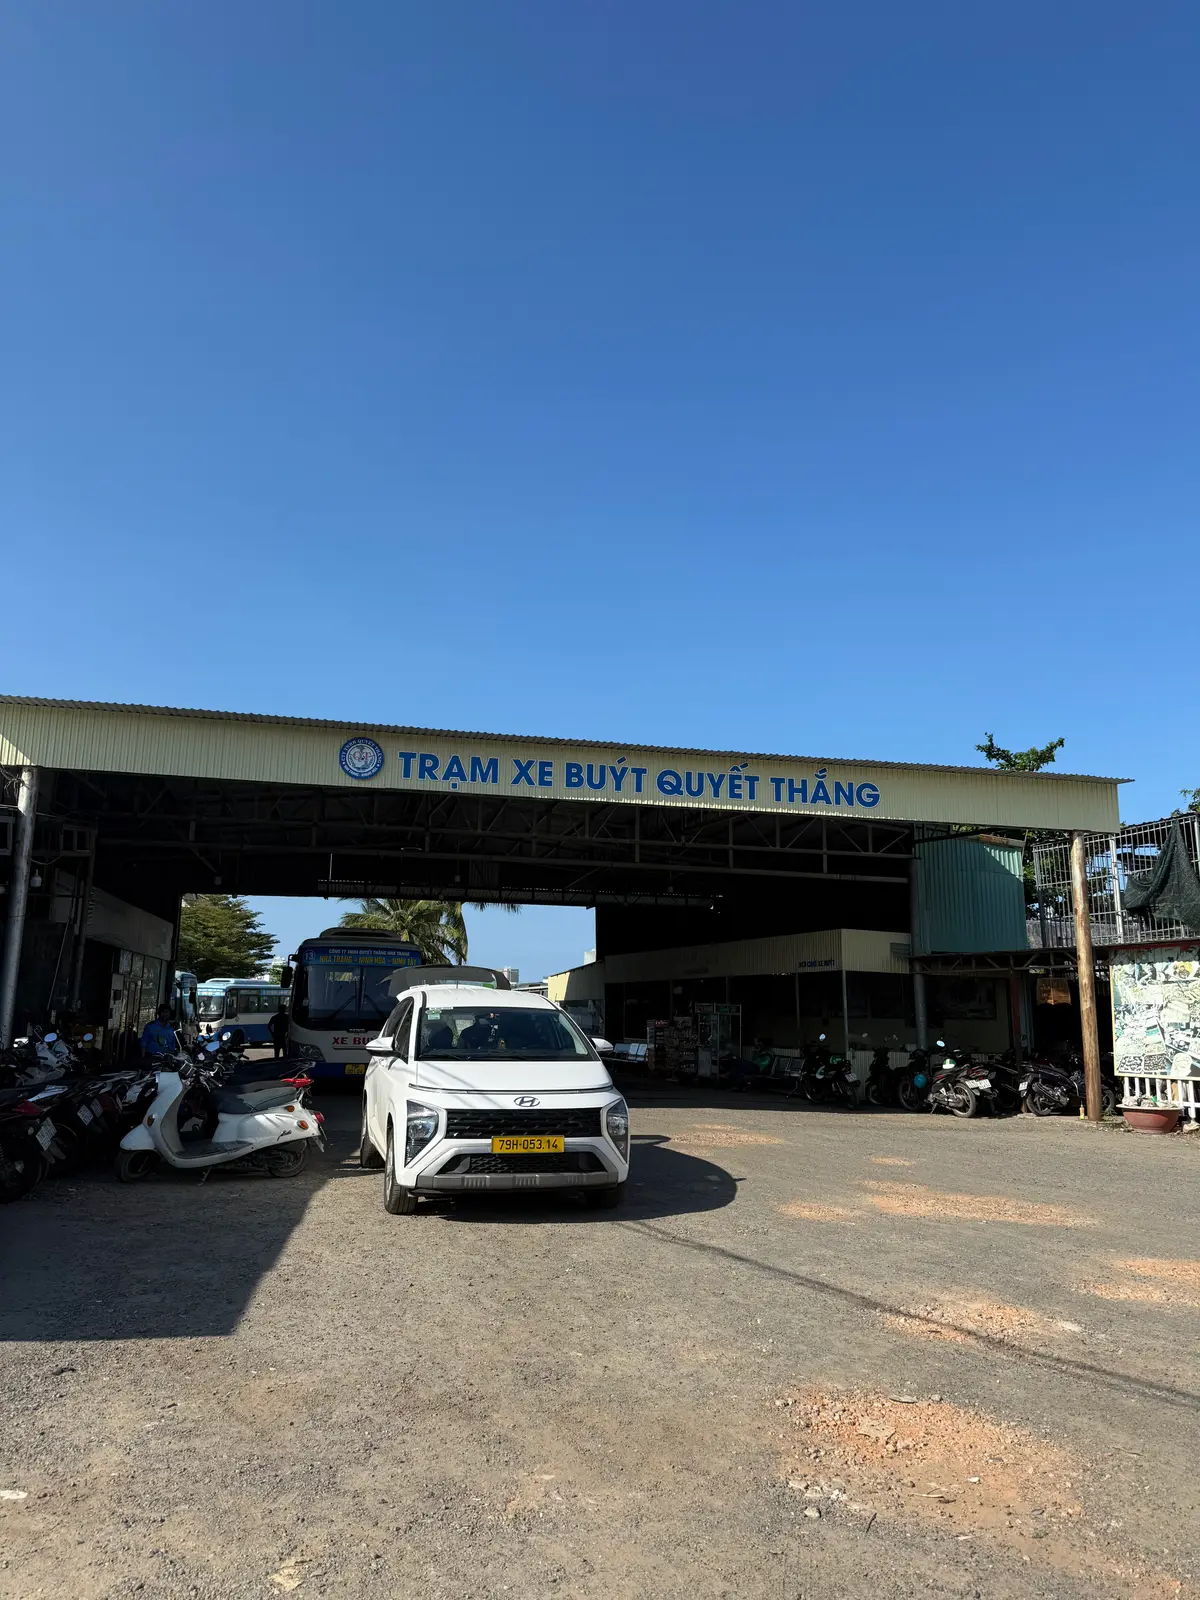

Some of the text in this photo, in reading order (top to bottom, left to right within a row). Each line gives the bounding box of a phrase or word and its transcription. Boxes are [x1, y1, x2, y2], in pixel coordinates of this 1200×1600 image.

[398, 751, 881, 808] TRẠM XE BUÝT QUYẾT THẮNG
[304, 952, 314, 961] 13
[333, 955, 353, 963] TRANG
[332, 1036, 348, 1045] XE
[499, 1139, 558, 1150] 79H-053.14
